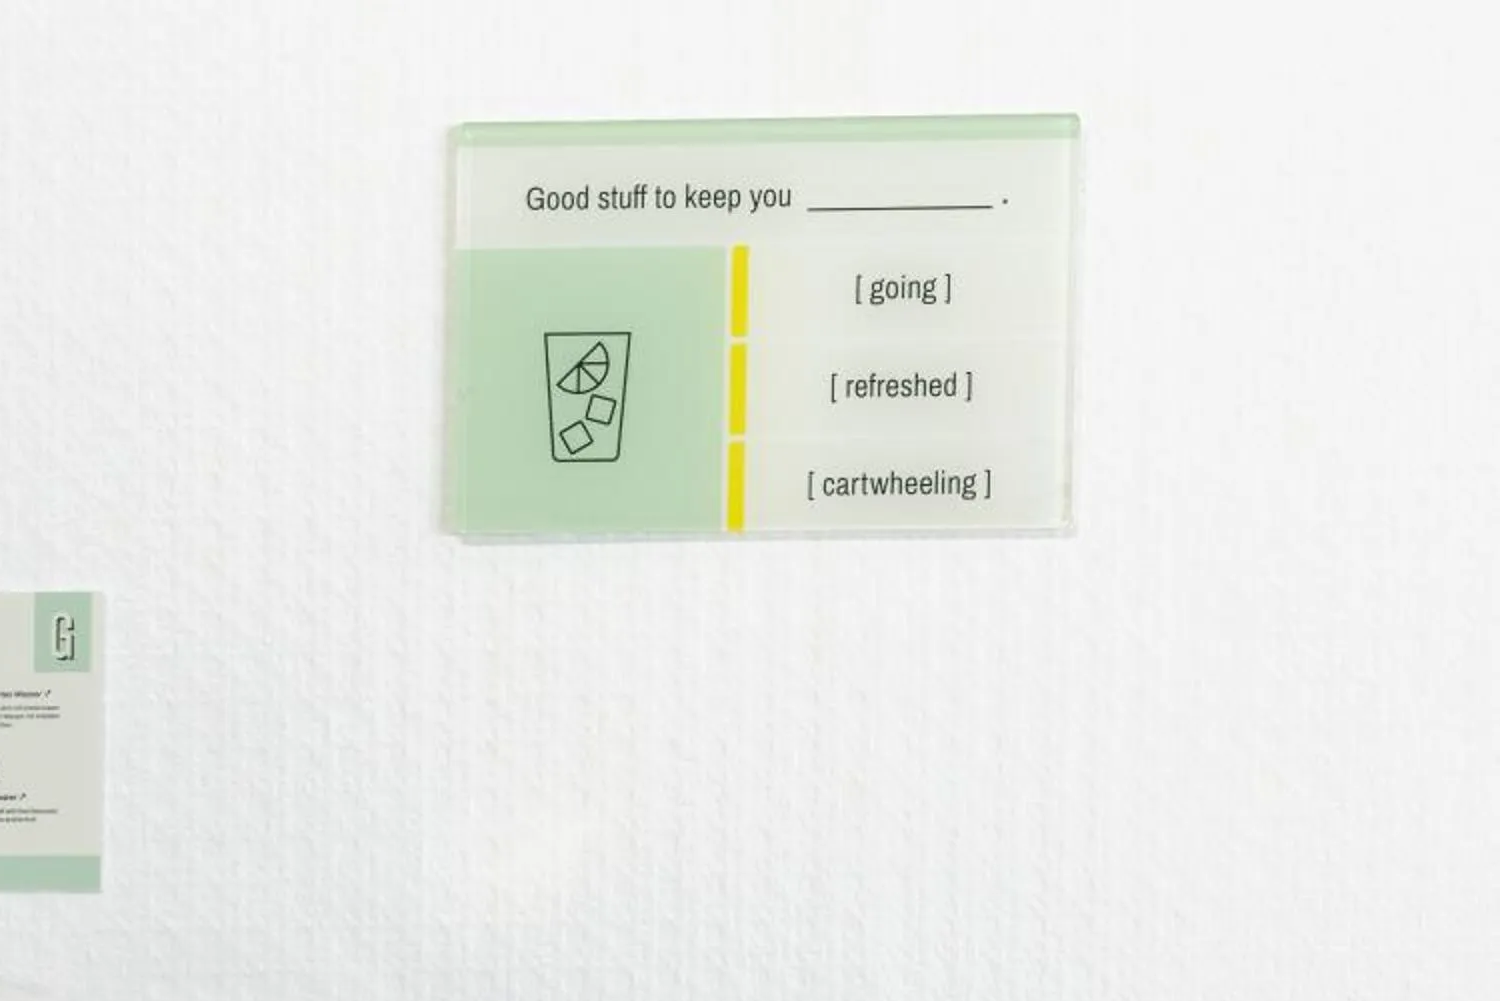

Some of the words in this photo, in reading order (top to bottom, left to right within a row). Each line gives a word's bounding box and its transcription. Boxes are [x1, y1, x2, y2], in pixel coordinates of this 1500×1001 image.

[525, 184, 590, 212] Good
[598, 183, 648, 211] stuff
[655, 185, 677, 210] to
[684, 182, 742, 214] keep
[749, 188, 792, 215] you
[869, 275, 938, 306] going
[845, 371, 958, 399] refreshed
[822, 470, 978, 501] cartwheeling
